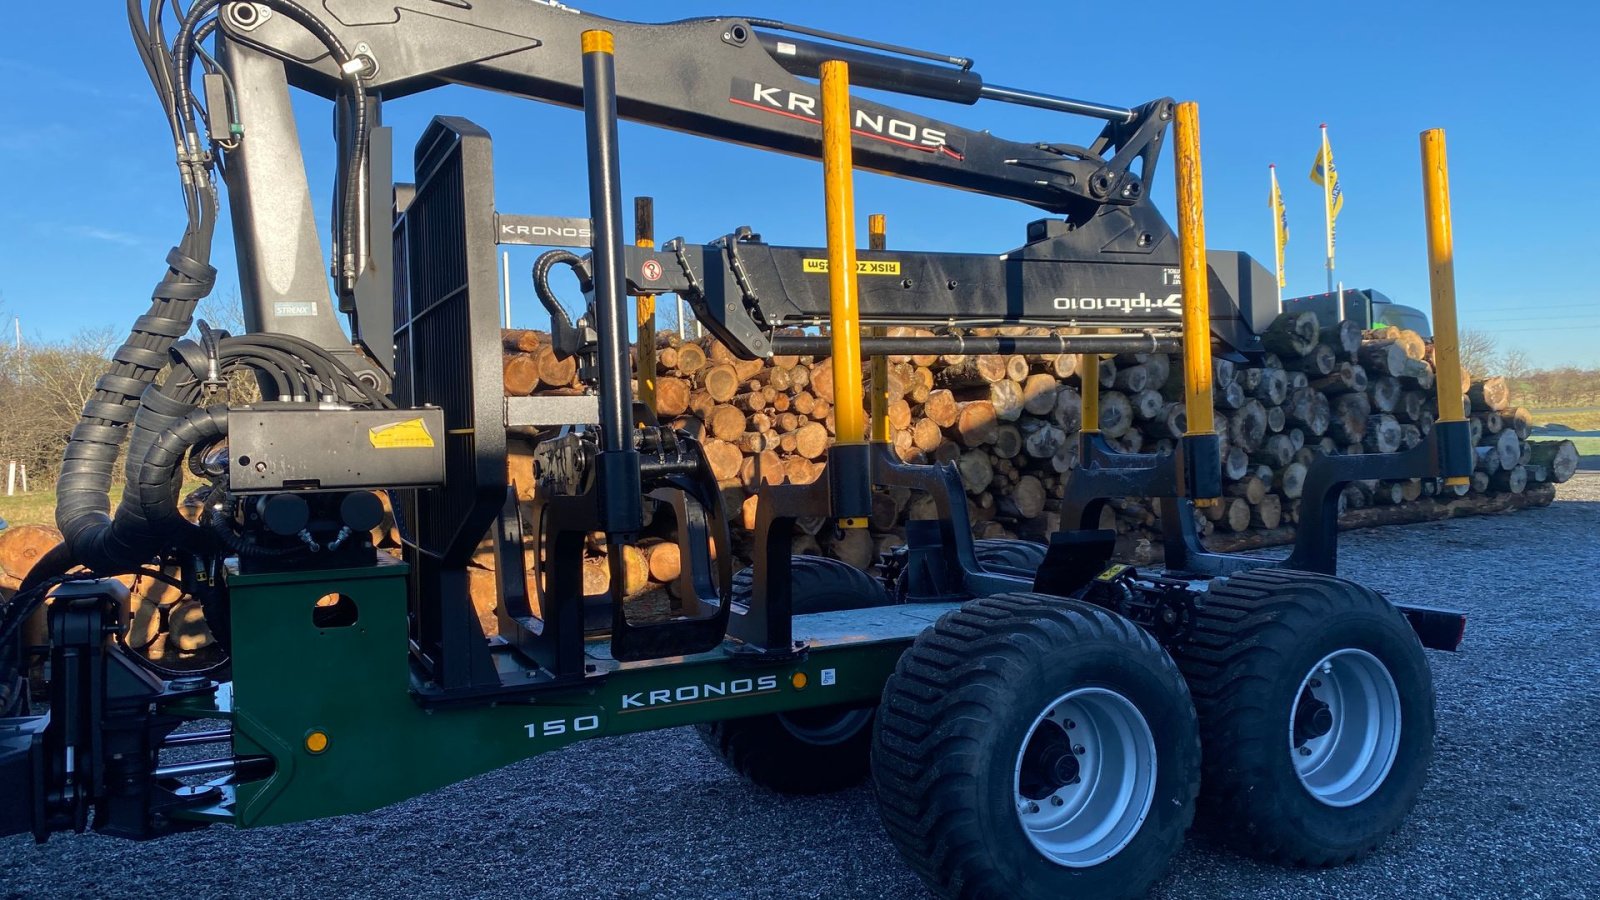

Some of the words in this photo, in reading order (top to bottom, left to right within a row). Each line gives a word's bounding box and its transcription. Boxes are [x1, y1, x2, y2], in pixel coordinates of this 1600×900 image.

[753, 83, 946, 146] KRNOS
[502, 224, 591, 237] KRONOS
[870, 263, 896, 273] RISK
[621, 674, 777, 709] KRONOS
[524, 715, 599, 738] 150
